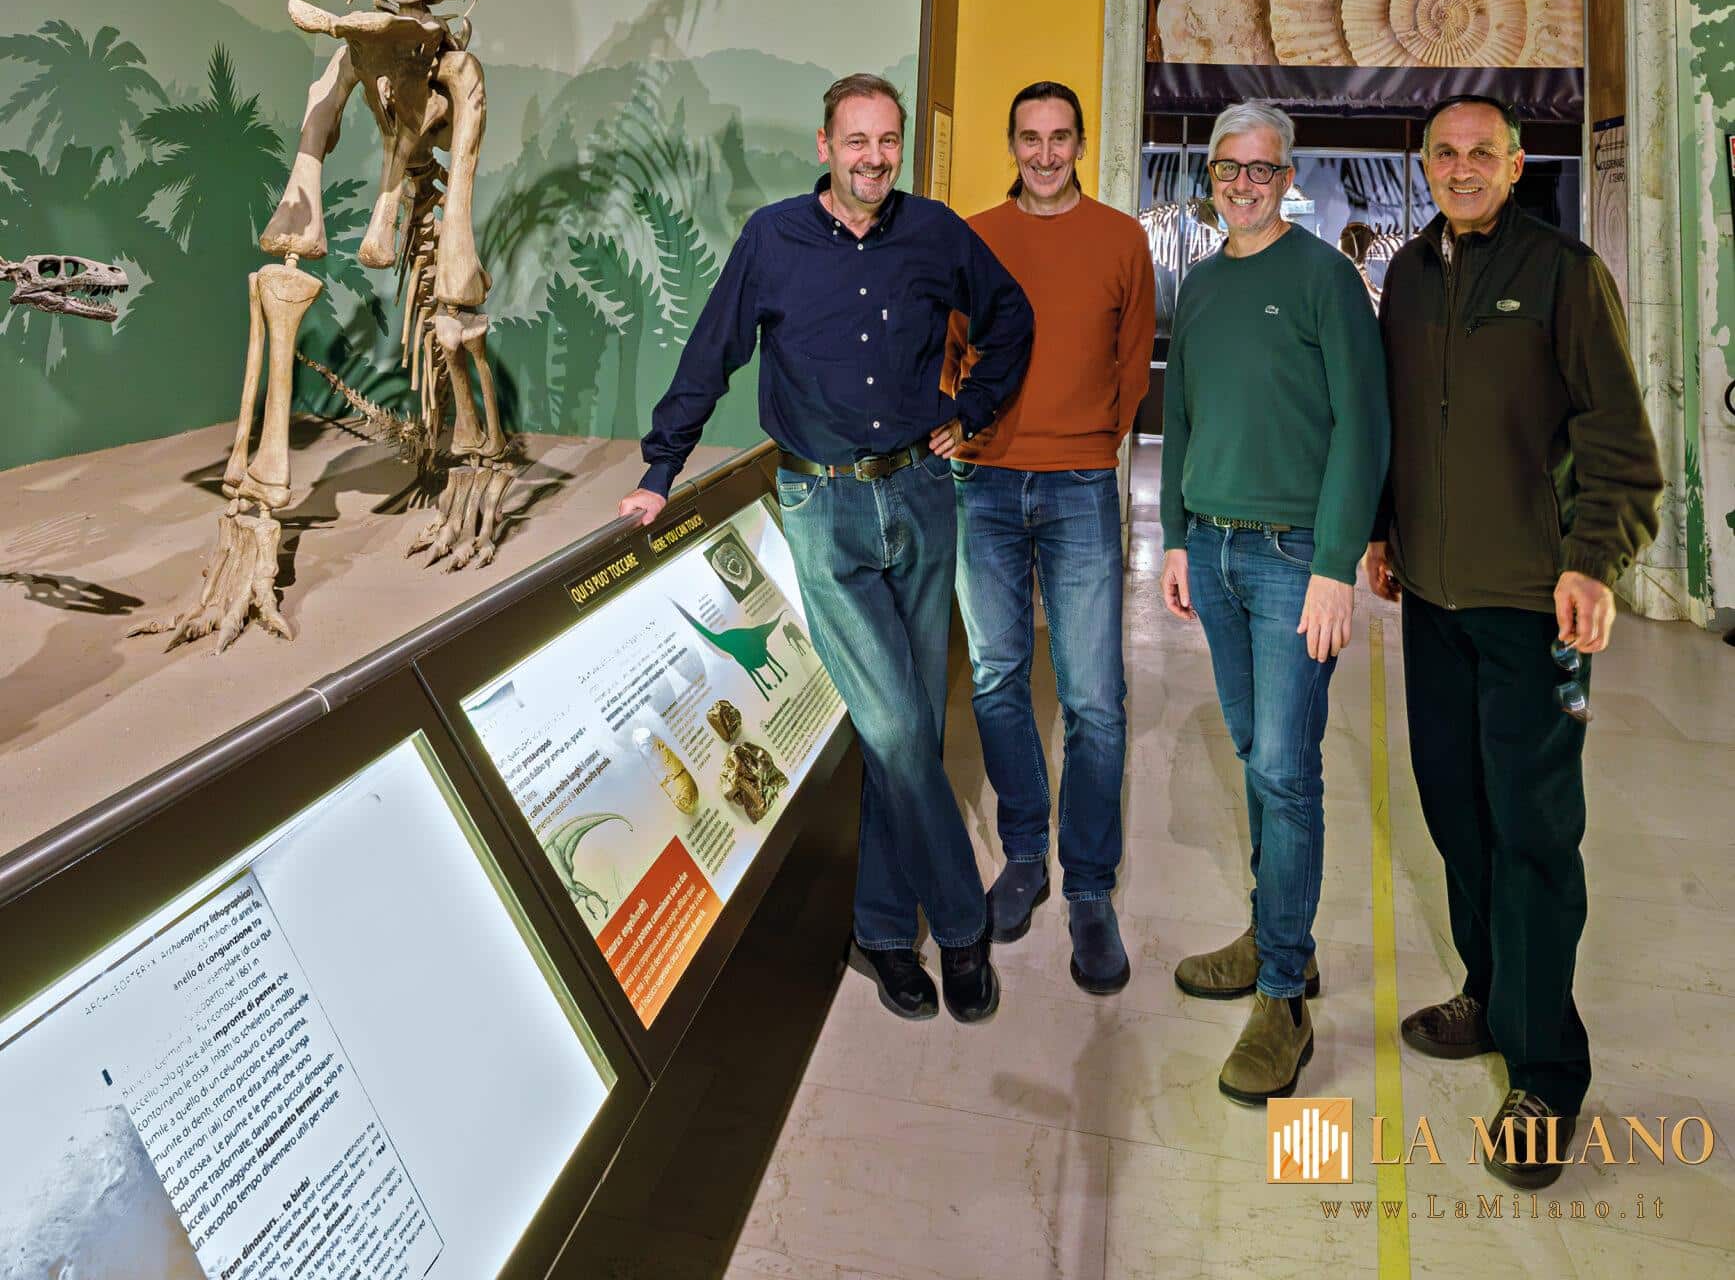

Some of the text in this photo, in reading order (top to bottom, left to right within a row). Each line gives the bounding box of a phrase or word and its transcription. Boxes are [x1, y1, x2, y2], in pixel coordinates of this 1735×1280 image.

[570, 552, 639, 604] QUI SI PUO' TOCCARE
[650, 514, 704, 553] HERE YOU CAN TOUCH
[172, 967, 197, 991] anello
[195, 960, 206, 972] di
[204, 924, 253, 965] congiunzione
[250, 916, 262, 929] tra
[198, 1037, 214, 1055] alle
[211, 1007, 247, 1042] impronte
[245, 998, 256, 1013] di
[253, 981, 277, 1007] penne
[247, 970, 268, 991] come
[136, 1085, 184, 1132] contornano
[181, 1077, 192, 1090] le
[274, 985, 295, 1007] molto
[143, 1121, 170, 1150] simile
[168, 1115, 176, 1127] a
[174, 1092, 201, 1121] quello
[199, 1084, 209, 1098] di
[207, 1074, 220, 1090] un
[266, 1015, 284, 1036] sono
[151, 1133, 183, 1166] munite
[181, 1124, 192, 1138] di
[211, 1081, 237, 1109] sterno
[235, 1058, 262, 1089] piccolo
[259, 1053, 267, 1064] e
[264, 1035, 286, 1059] senza
[158, 1164, 176, 1184] arti
[206, 1116, 223, 1137] (ali)
[221, 1103, 238, 1123] con
[235, 1093, 249, 1109] tre
[246, 1079, 263, 1099] dita
[288, 1033, 310, 1056] lunga
[166, 1174, 190, 1201] coda
[212, 1139, 225, 1155] Le
[222, 1116, 248, 1146] piume
[246, 1110, 254, 1121] e
[251, 1102, 261, 1116] le
[281, 1068, 296, 1086] che
[294, 1052, 312, 1074] sono
[173, 1179, 209, 1220] squame
[250, 1109, 278, 1141] davano
[282, 1079, 306, 1109] piccoli
[181, 1203, 208, 1238] uccelli
[205, 1190, 223, 1212] un
[220, 1153, 257, 1196] maggiore
[254, 1111, 297, 1159] isolamento
[322, 1068, 338, 1088] solo
[190, 1234, 205, 1253] un
[203, 1198, 238, 1240] secondo
[235, 1171, 263, 1204] tempo
[260, 1134, 297, 1177] divennero
[307, 1108, 321, 1128] per
[219, 1255, 242, 1280] From
[281, 1197, 292, 1212] to
[288, 1174, 310, 1203] birds!
